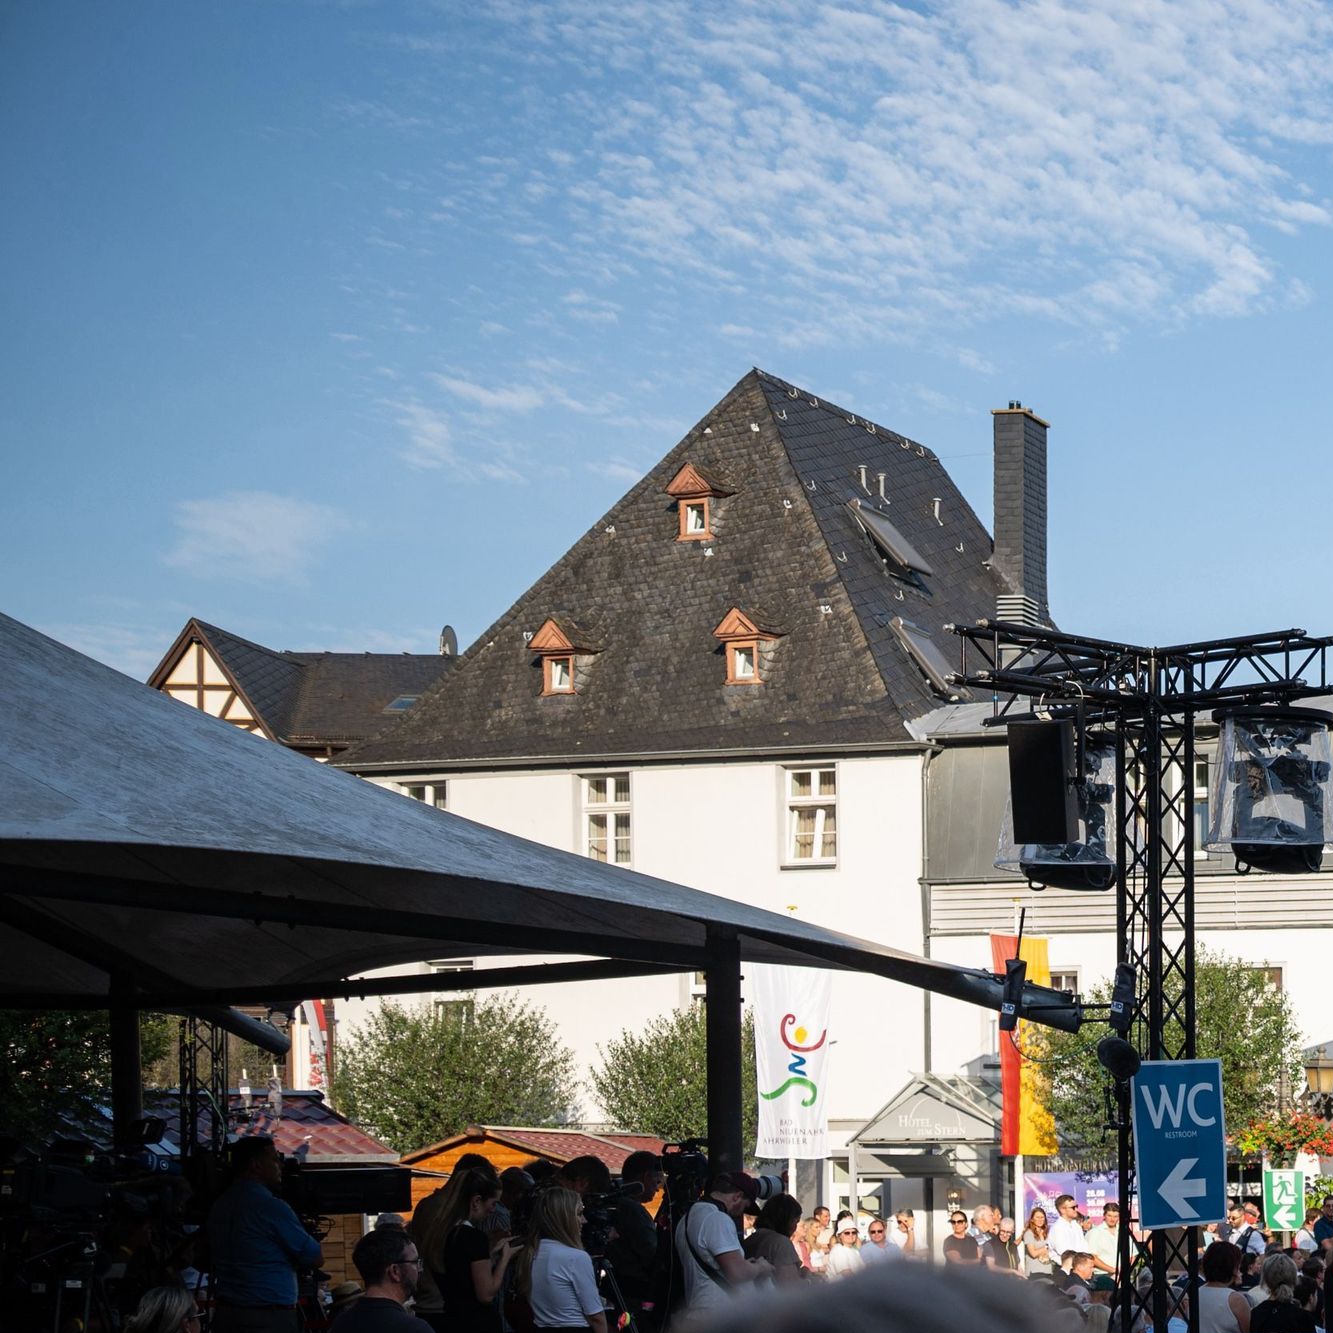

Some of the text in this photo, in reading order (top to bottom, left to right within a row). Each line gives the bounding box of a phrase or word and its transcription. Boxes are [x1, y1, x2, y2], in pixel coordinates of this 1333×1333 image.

[1140, 1082, 1217, 1130] WC
[898, 1114, 932, 1127] HOTEL
[934, 1123, 967, 1136] STERN
[1164, 1130, 1198, 1139] RESTROOM
